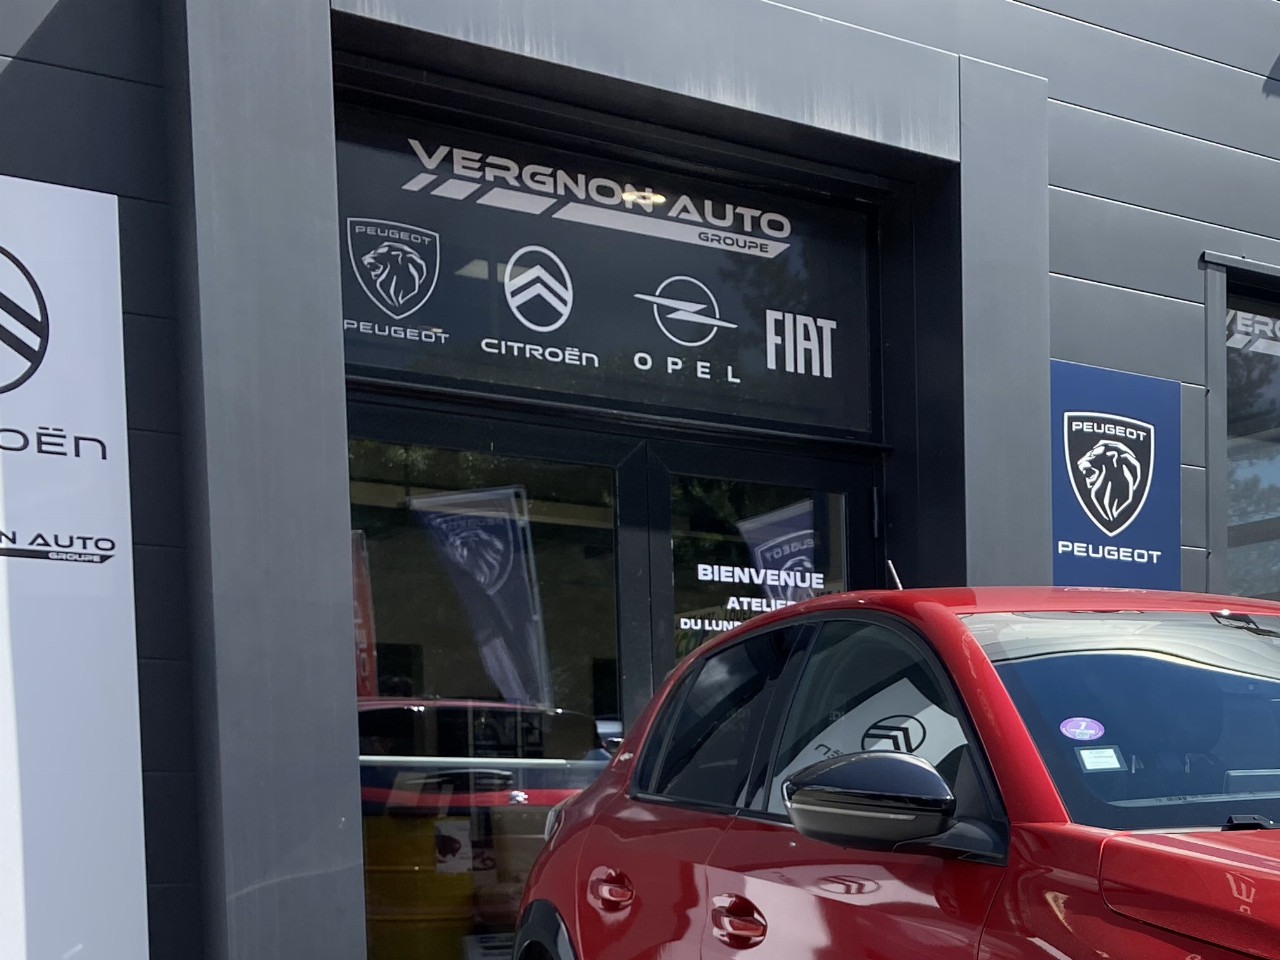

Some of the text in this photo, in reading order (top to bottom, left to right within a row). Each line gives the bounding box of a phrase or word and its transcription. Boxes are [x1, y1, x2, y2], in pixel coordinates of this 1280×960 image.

[407, 138, 792, 239] VERGNON AUTO
[355, 225, 432, 246] PEUGEOT
[698, 231, 770, 254] GROUPE
[343, 319, 450, 345] PEUGEOT
[765, 308, 838, 379] FIAT
[480, 337, 600, 369] CITROËN
[633, 352, 742, 384] OPEL
[1071, 421, 1147, 442] PEUGEOT
[28, 532, 116, 552] AUTO
[1057, 540, 1162, 564] PEUGEOT
[48, 551, 101, 563] GROUPE
[697, 563, 825, 589] BIENVENUE
[726, 596, 798, 613] ATELIE
[680, 617, 702, 630] DU
